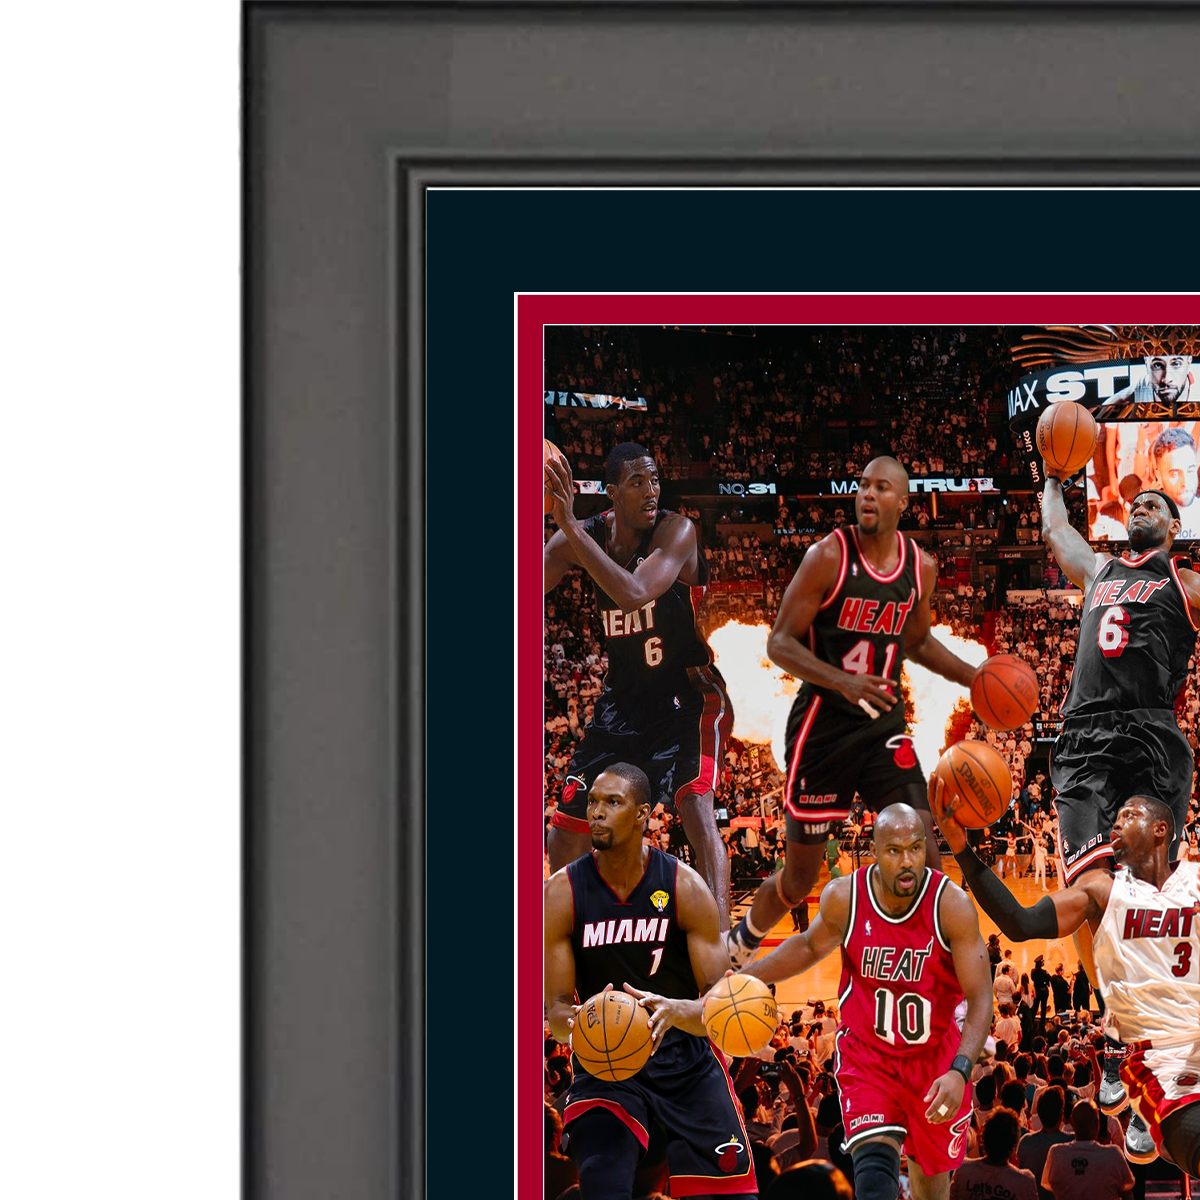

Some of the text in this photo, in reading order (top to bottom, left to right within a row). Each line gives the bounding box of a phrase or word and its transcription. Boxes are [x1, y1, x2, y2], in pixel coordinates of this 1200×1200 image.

[1023, 430, 1033, 452] UKG
[831, 480, 860, 494] MA
[1030, 460, 1039, 483] UKG
[1089, 577, 1171, 611] HEAT
[837, 588, 915, 635] HEAT
[1098, 606, 1130, 658] 6
[643, 635, 664, 668] 6
[842, 639, 897, 695] 41
[799, 794, 837, 804] MIAMI
[956, 761, 997, 818] SPALDING
[582, 918, 670, 949] MIAMI
[1123, 901, 1200, 939] HEAT
[649, 947, 664, 977] 1
[861, 936, 934, 982] HEAT
[1171, 941, 1193, 978] 3
[874, 987, 932, 1046] 10
[850, 1114, 884, 1130] MIAMI
